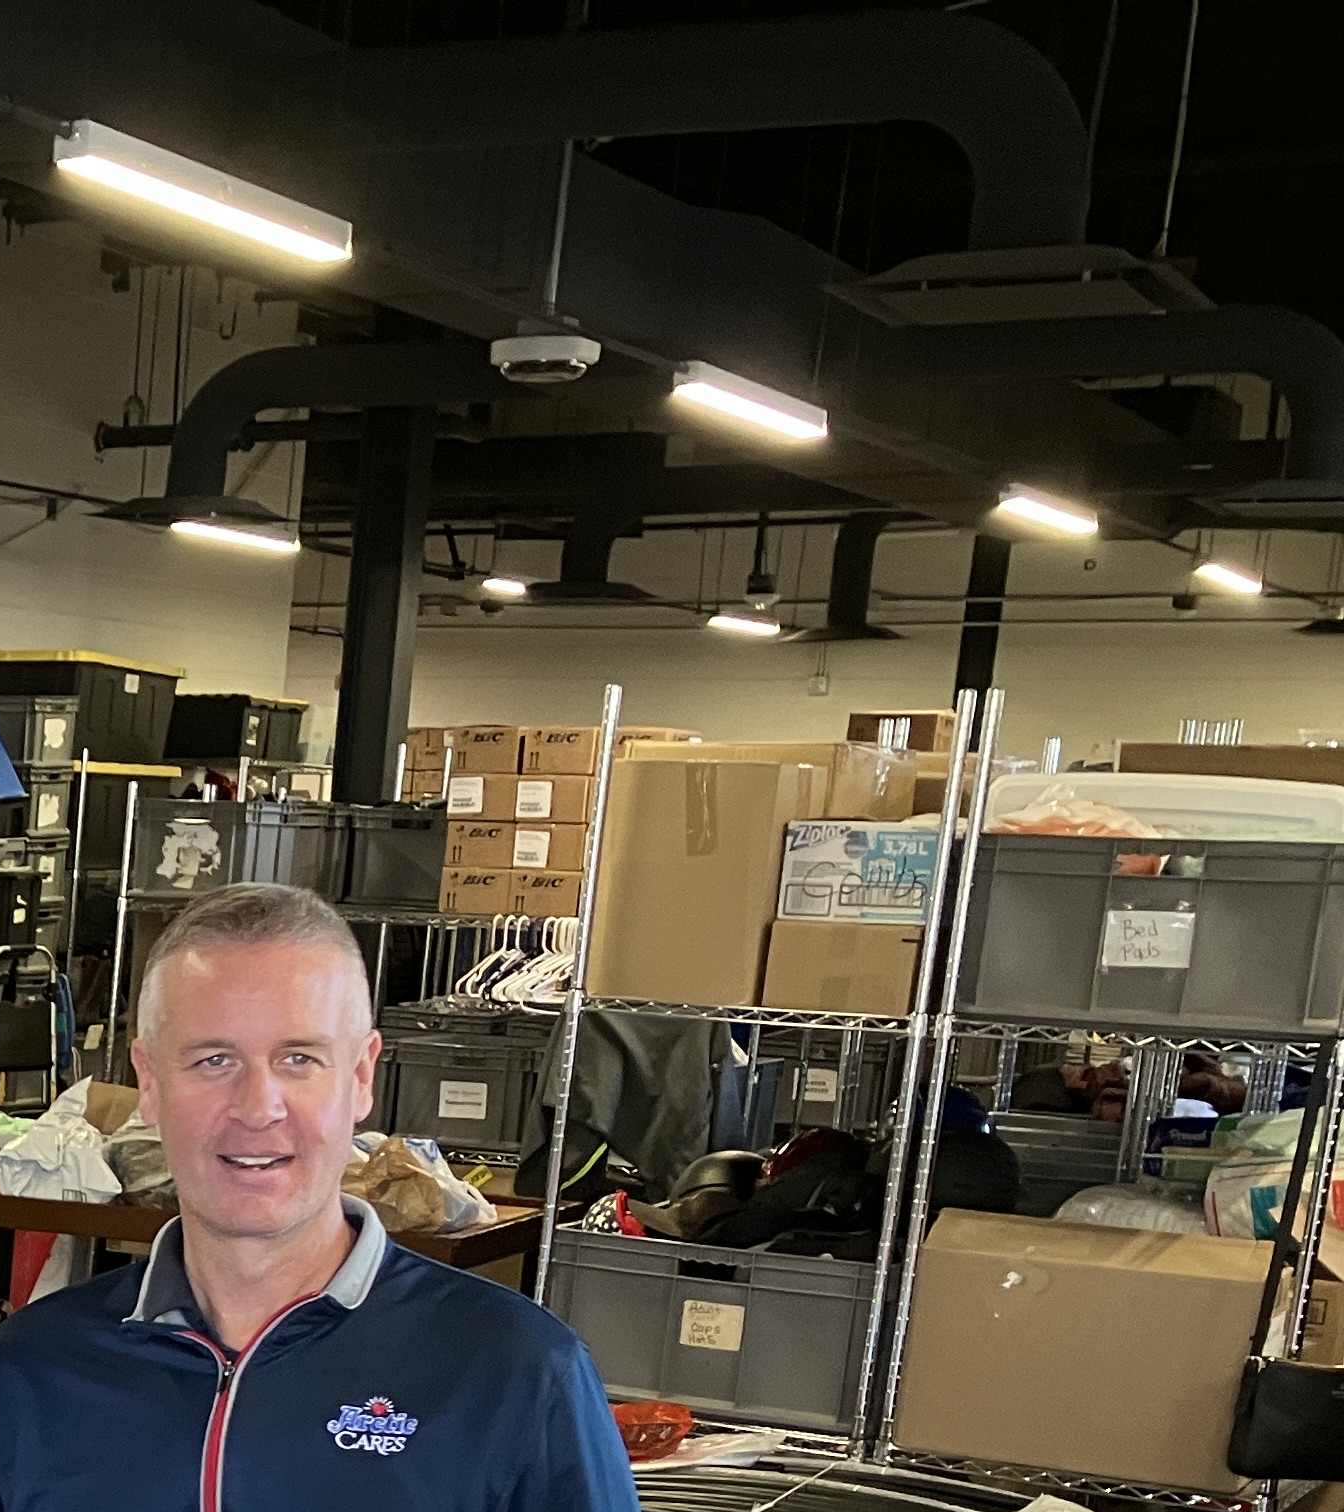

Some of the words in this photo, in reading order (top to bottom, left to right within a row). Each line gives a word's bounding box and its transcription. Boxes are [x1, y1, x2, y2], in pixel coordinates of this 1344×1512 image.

[789, 824, 849, 851] Ziploc
[1122, 919, 1159, 941] Bed
[1122, 941, 1160, 961] Pads
[327, 1405, 418, 1435] Arctic
[335, 1431, 407, 1455] CARES
